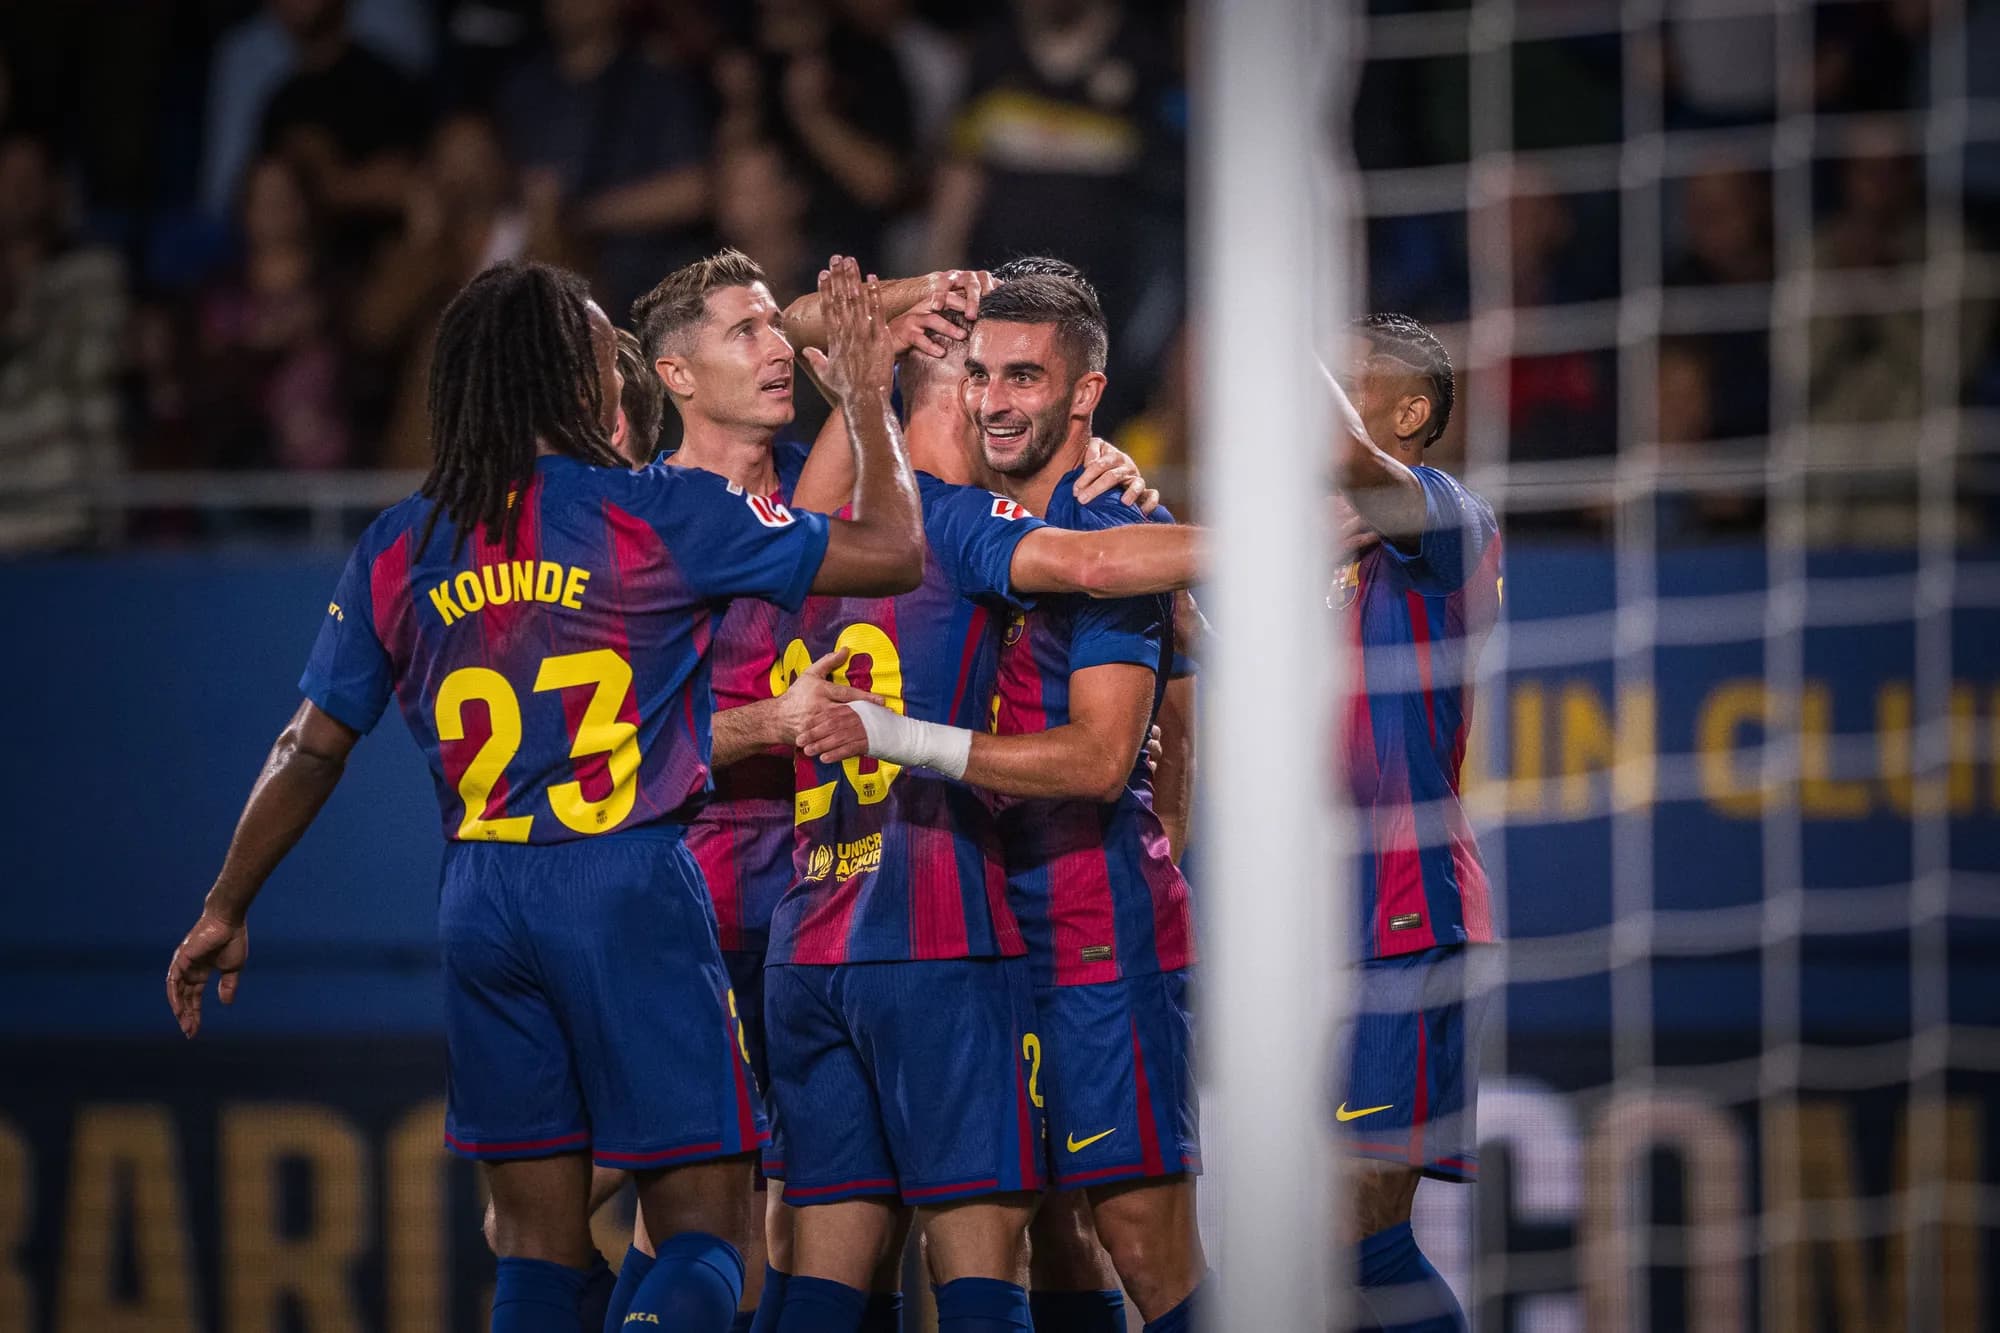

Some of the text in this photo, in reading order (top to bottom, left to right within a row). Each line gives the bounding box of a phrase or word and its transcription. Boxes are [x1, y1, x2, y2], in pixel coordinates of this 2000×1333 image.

[428, 560, 591, 627] KOUNDE
[434, 648, 642, 843] 23
[1691, 673, 2000, 820] CLU
[836, 832, 882, 859] UNHCR
